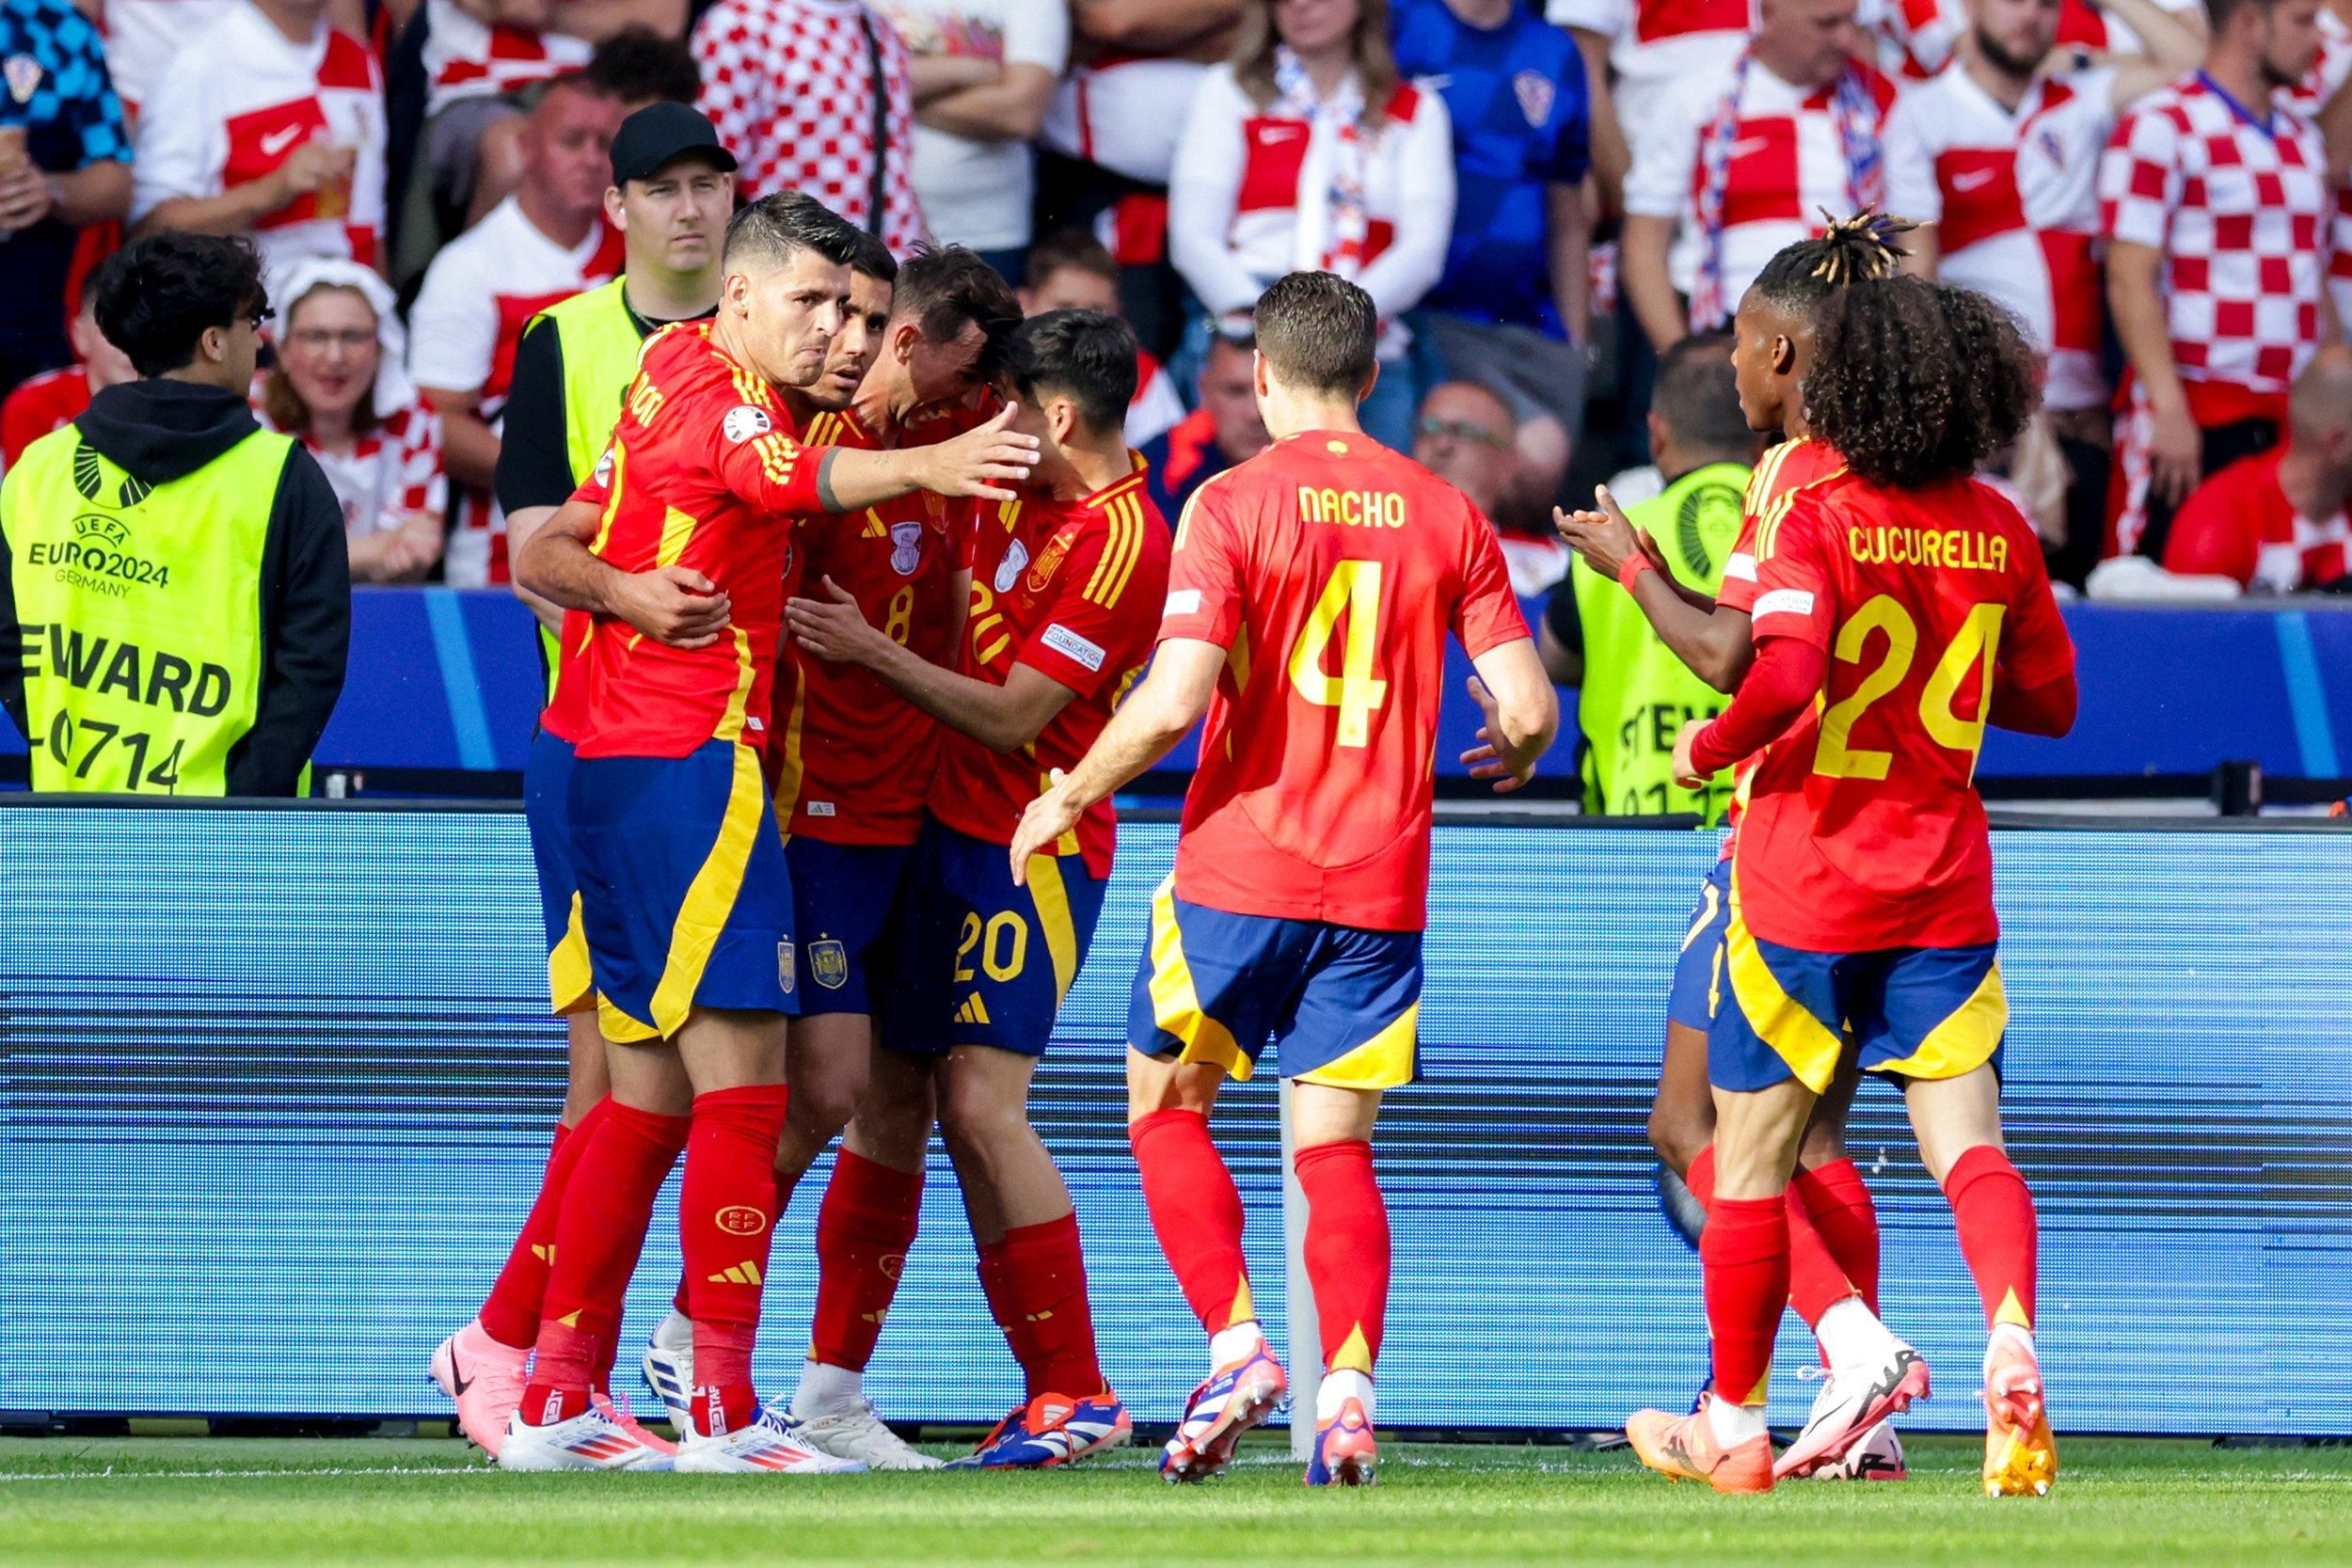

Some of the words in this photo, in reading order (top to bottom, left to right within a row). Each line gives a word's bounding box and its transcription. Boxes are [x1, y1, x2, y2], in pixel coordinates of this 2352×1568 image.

[1298, 485, 1406, 529] NACHO
[74, 518, 126, 546] UEFA
[1849, 526, 2009, 574] CUCURELLA
[28, 542, 169, 590] EURO2024
[55, 568, 132, 598] GERMANY
[884, 583, 914, 646] 8
[1046, 629, 1102, 665] FOUNDATION
[1288, 559, 1387, 749] 4
[1812, 593, 2008, 789] 24
[953, 910, 1028, 983] 20
